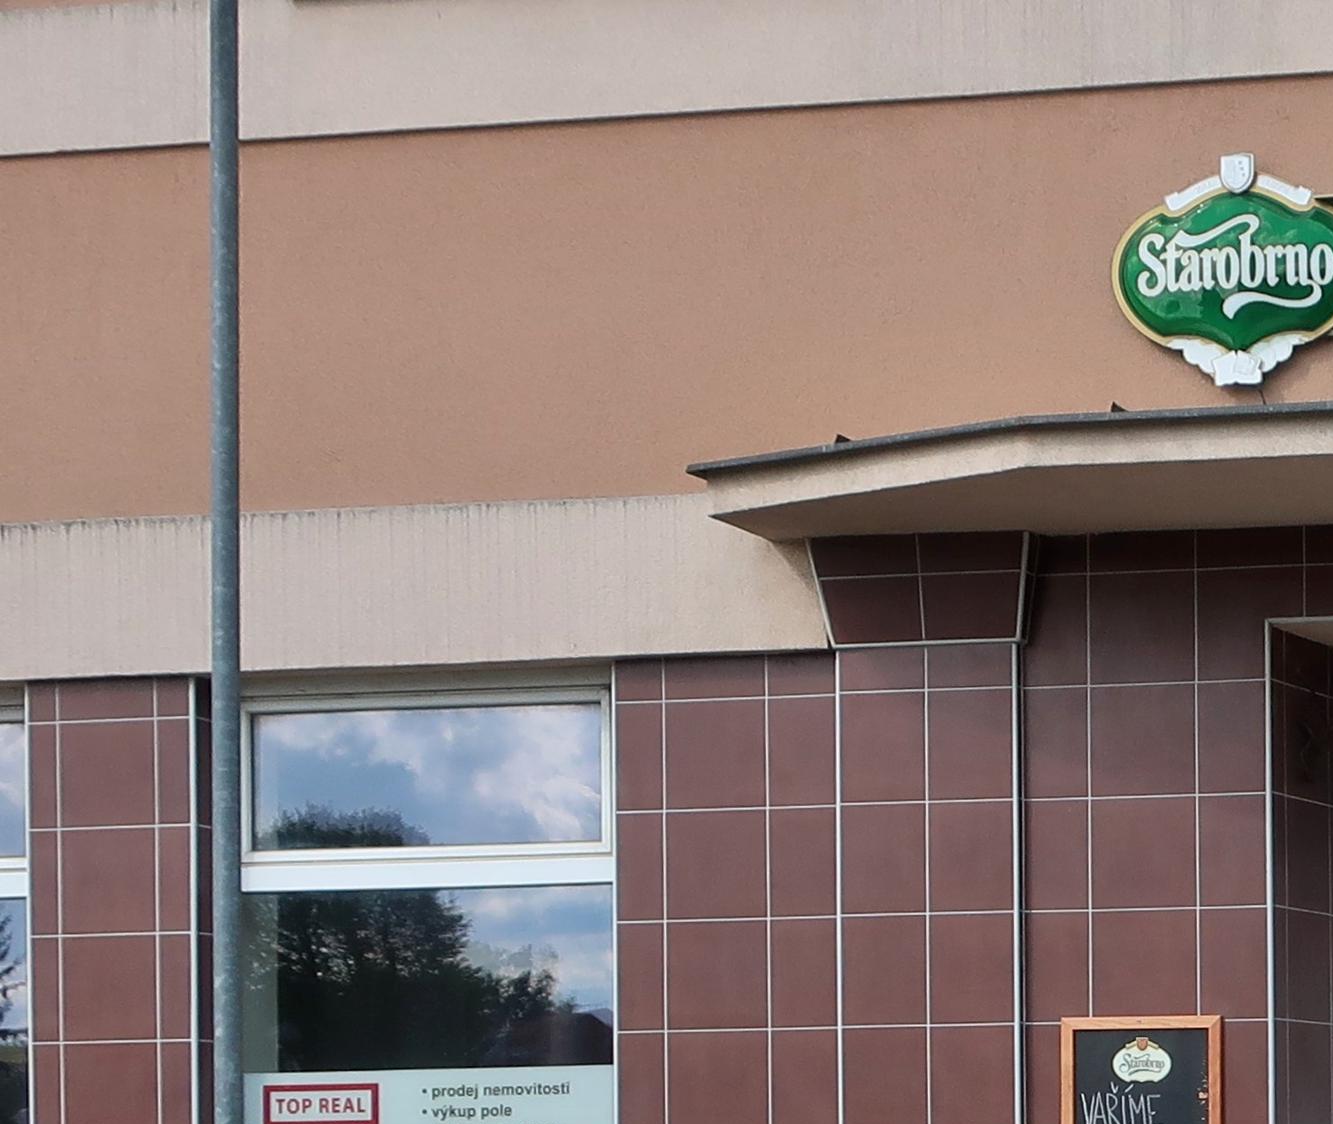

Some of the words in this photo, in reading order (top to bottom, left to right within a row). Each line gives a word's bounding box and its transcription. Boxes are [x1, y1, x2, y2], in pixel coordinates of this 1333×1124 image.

[431, 1083, 478, 1100] prodej
[275, 1097, 312, 1114] TOP
[319, 1096, 367, 1113] REAL
[431, 1104, 476, 1121] výkup
[480, 1104, 512, 1120] pole
